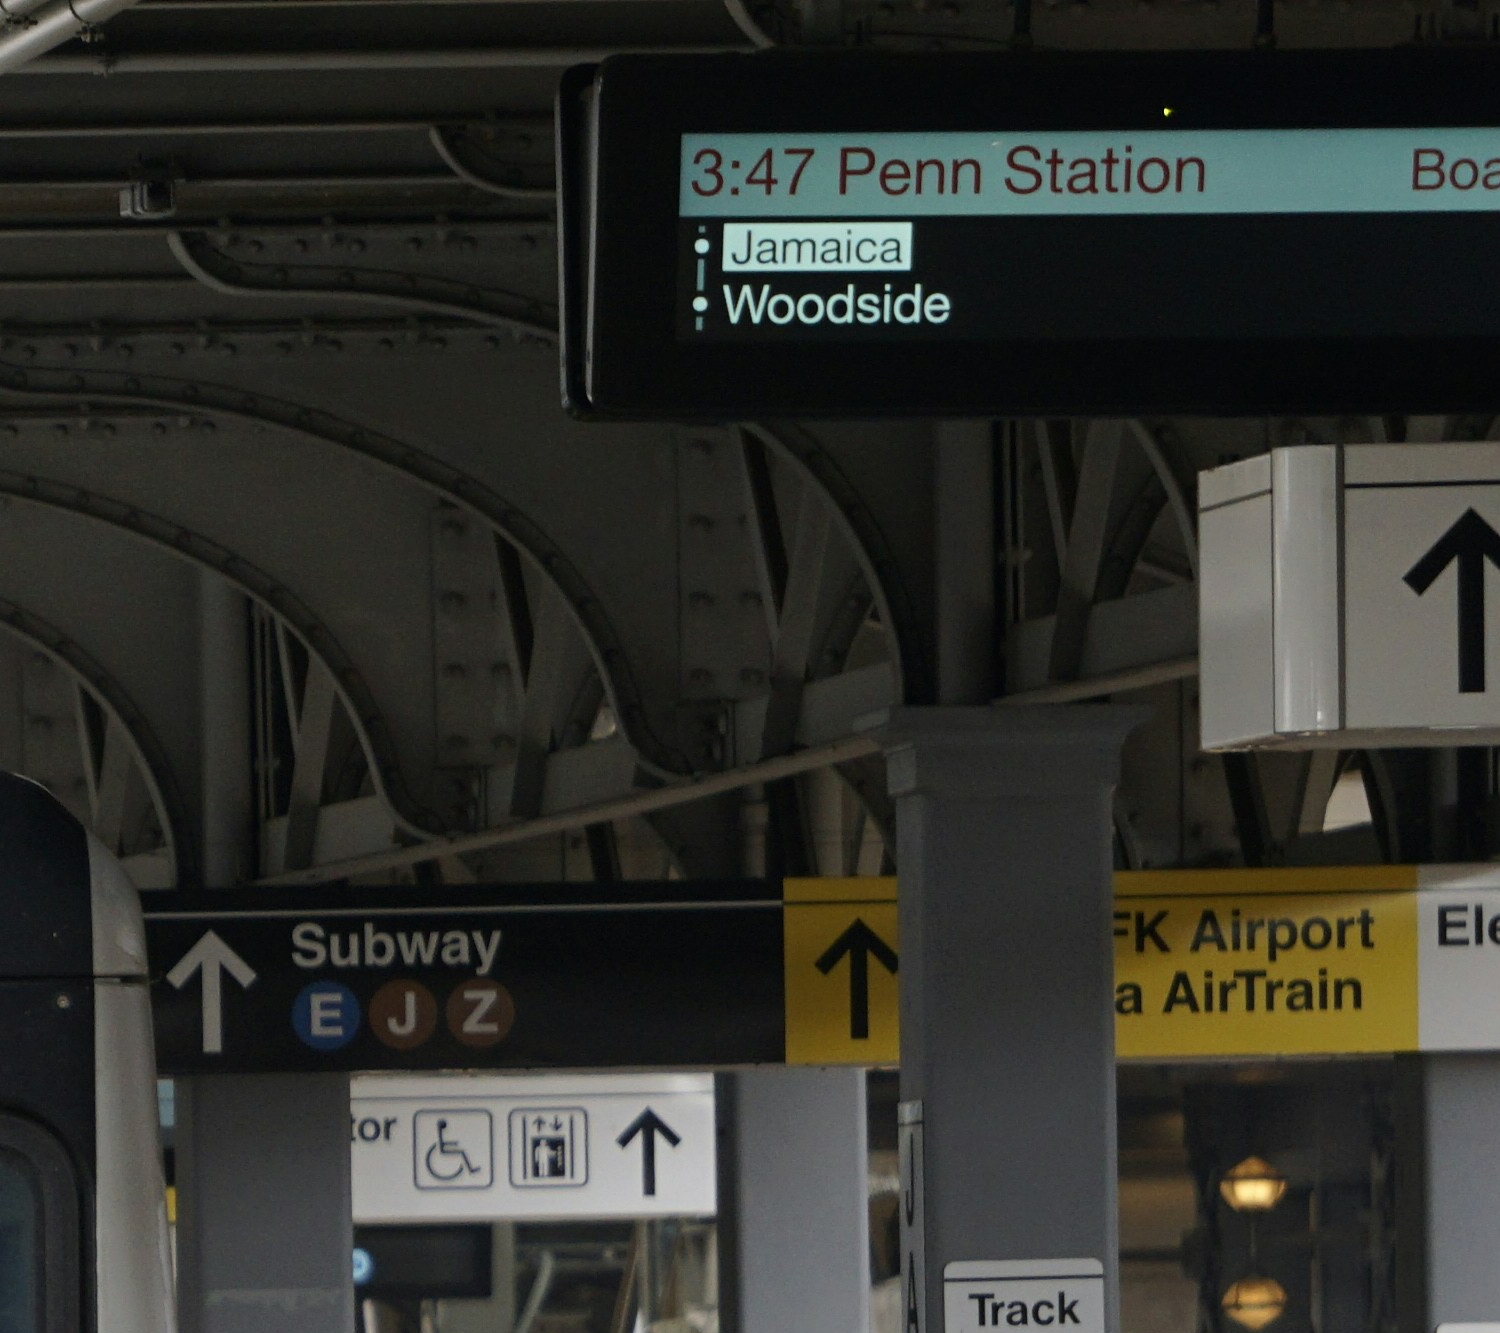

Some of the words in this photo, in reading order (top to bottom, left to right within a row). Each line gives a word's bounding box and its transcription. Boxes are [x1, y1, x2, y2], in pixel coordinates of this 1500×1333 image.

[691, 147, 815, 197] 3:47
[839, 146, 982, 196] Penn
[1004, 144, 1206, 195] Station
[731, 229, 903, 266] Jamaica
[722, 283, 951, 325] Woodside
[291, 922, 501, 976] Subway
[1189, 908, 1375, 963] Airport
[310, 992, 344, 1037] E
[387, 991, 417, 1036] J
[462, 989, 499, 1034] Z
[1162, 968, 1362, 1014] AirTrain
[968, 1291, 1081, 1327] Track
